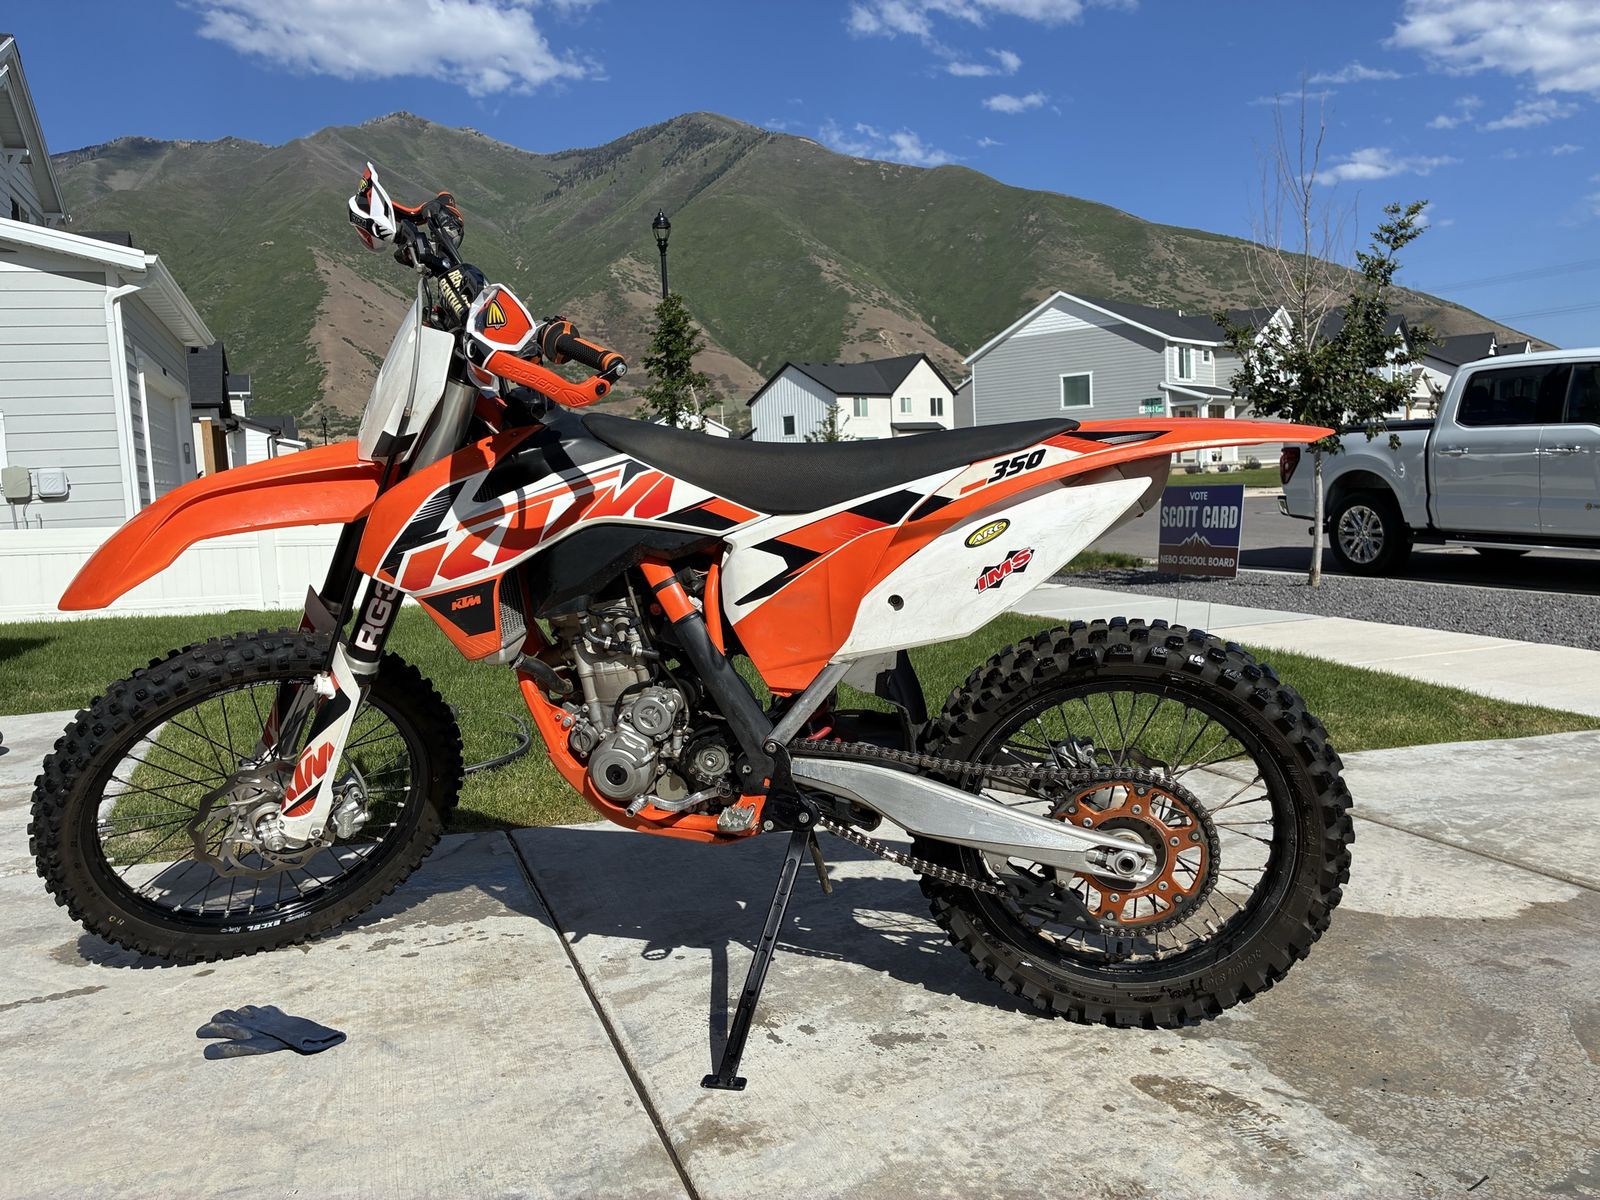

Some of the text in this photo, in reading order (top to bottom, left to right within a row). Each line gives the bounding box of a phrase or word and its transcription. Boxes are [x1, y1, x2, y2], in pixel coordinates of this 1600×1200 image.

[988, 449, 1046, 484] 350
[1189, 491, 1208, 500] VOTE
[1161, 505, 1239, 529] SCOTT CARD
[976, 547, 1034, 594] IMS
[1160, 554, 1235, 568] NEBO SCHOOL BOARD
[452, 595, 481, 611] KTM
